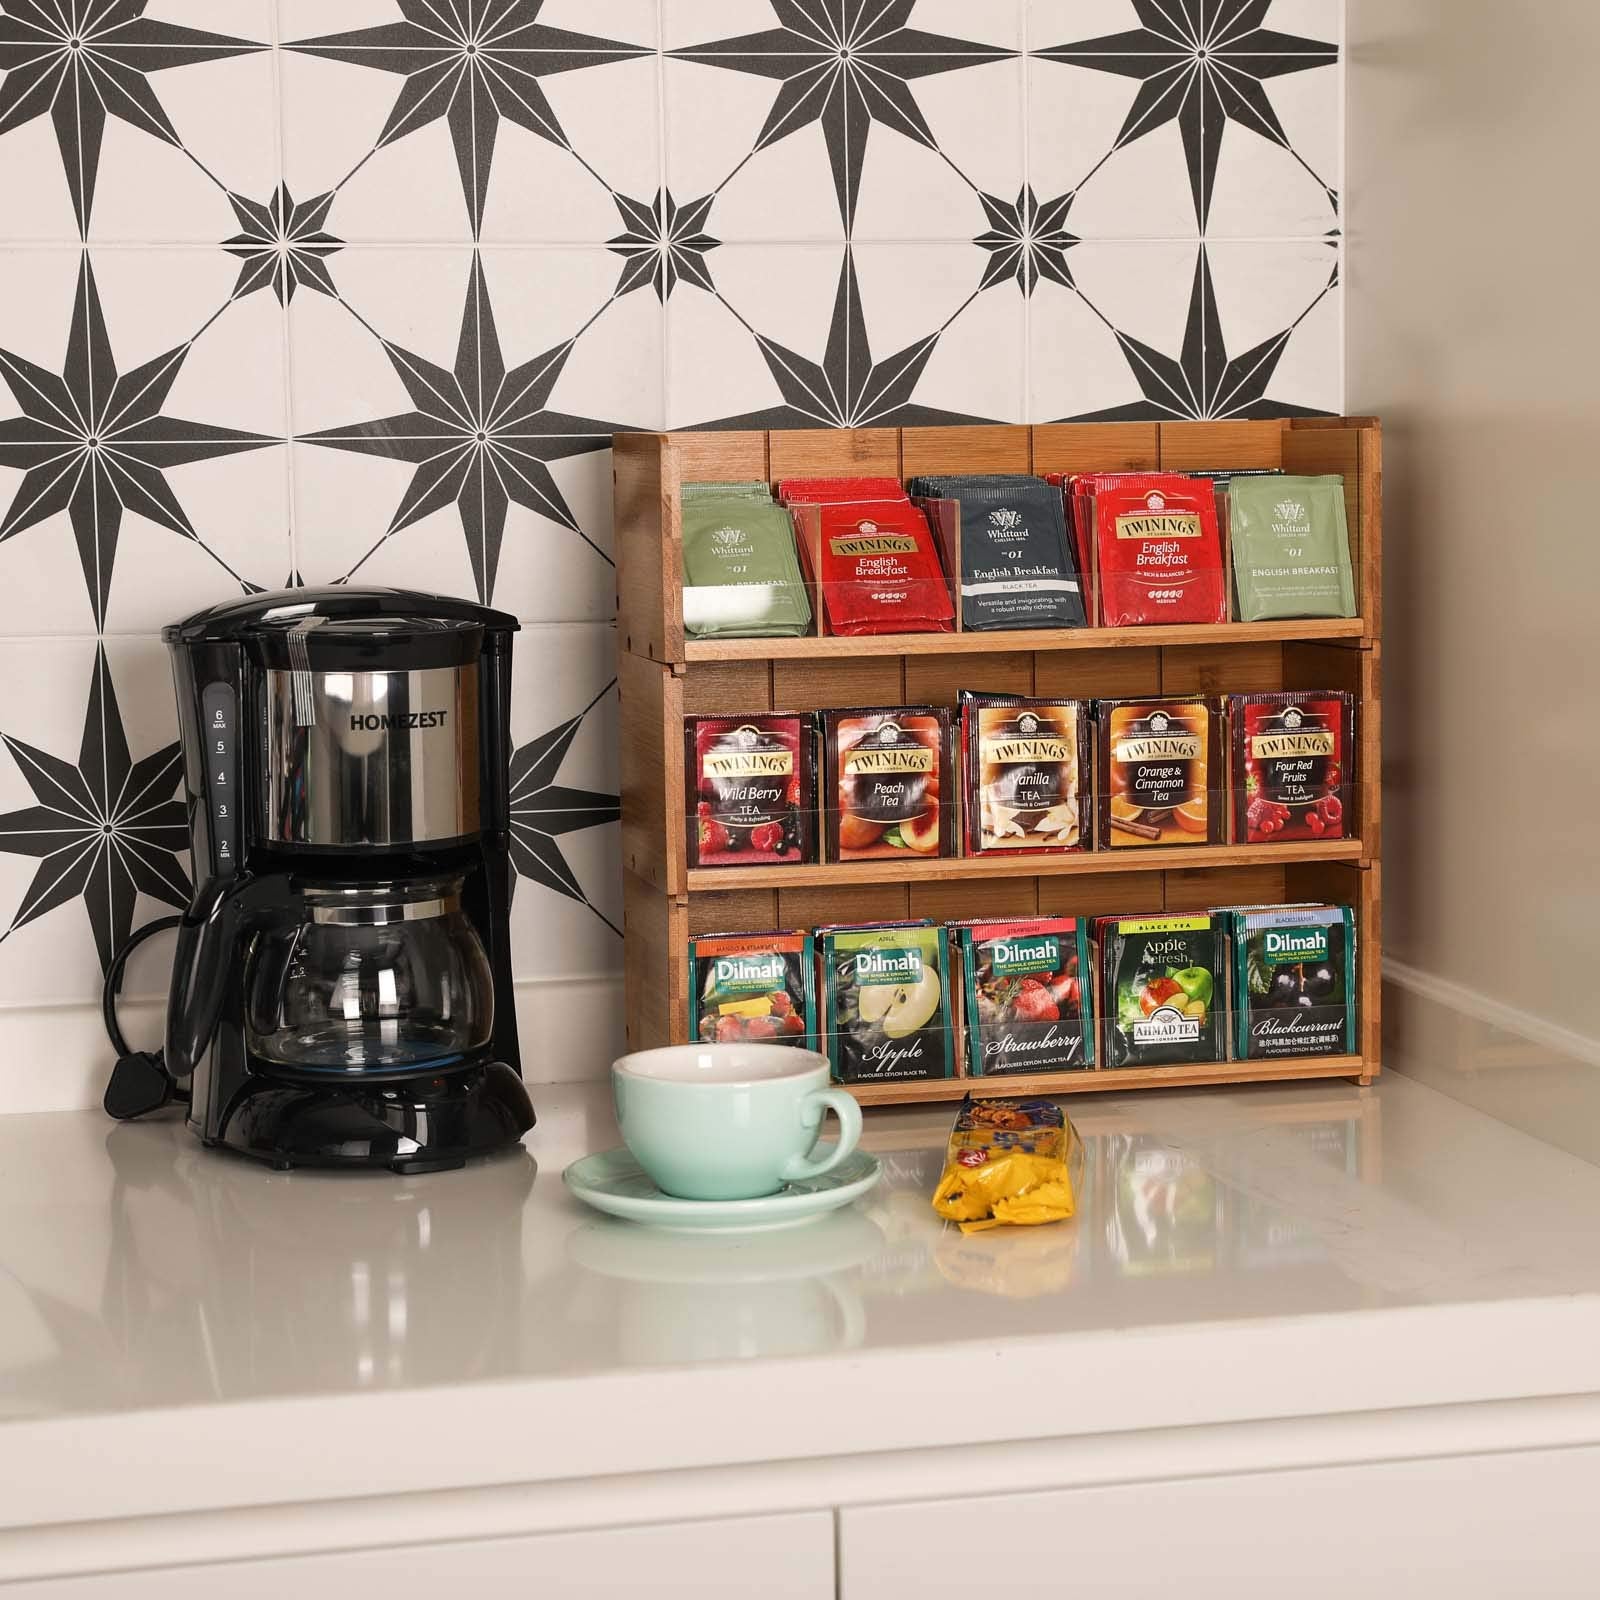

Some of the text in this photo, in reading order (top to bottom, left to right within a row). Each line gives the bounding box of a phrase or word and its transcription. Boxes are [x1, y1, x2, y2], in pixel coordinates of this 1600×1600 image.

[1122, 518, 1196, 536] TWININGS
[1271, 523, 1310, 533] Whittard
[986, 528, 1030, 539] Whittard
[711, 544, 754, 555] Whittard
[836, 538, 912, 554] TWININGS
[1142, 541, 1180, 555] English
[860, 557, 898, 568] English
[1136, 554, 1188, 567] Breakfast
[855, 566, 908, 576] Breakfast
[974, 565, 1059, 580] English Breakfast
[1252, 566, 1338, 577] ENGLISH BREAKFAST
[977, 599, 1004, 608] Versatile
[1004, 598, 1017, 606] and
[1054, 596, 1066, 604] with
[996, 605, 1016, 613] robust
[1016, 604, 1032, 612] malty
[215, 710, 223, 720] 6
[350, 710, 447, 731] HOMEZEST
[217, 741, 225, 751] 5
[993, 741, 1066, 760] TWININGS
[1126, 740, 1196, 759] TWININGS
[1257, 737, 1329, 756] TWININGS
[712, 755, 788, 774] TWININGS
[850, 752, 927, 771] TWININGS
[1275, 760, 1313, 771] Four Red
[218, 772, 225, 782] 4
[1137, 766, 1182, 778] Orange &
[1282, 772, 1307, 782] Fruits
[1011, 773, 1050, 786] Vanilla
[1135, 778, 1184, 790] Cinnamon
[719, 786, 782, 802] Wild Berry
[874, 782, 904, 794] Peach
[1286, 785, 1306, 795] TEA
[880, 795, 899, 806] Tea
[1020, 791, 1040, 800] TEA
[1151, 790, 1169, 801] Tea
[220, 805, 228, 814] 3
[739, 806, 760, 815] TEA
[221, 840, 228, 850] 2
[1144, 939, 1187, 954] Apple
[1266, 931, 1326, 952] Dilmah
[994, 940, 1057, 964] Dilmah
[856, 952, 920, 973] Dilmah
[718, 959, 784, 980] Dilmah
[1136, 1023, 1198, 1037] AHMAD TEA
[1252, 1013, 1344, 1036] Blackcurrant
[985, 1025, 1081, 1061] Strawberry
[862, 1038, 924, 1072] Apple
[995, 1062, 1022, 1070] FLAVOURED
